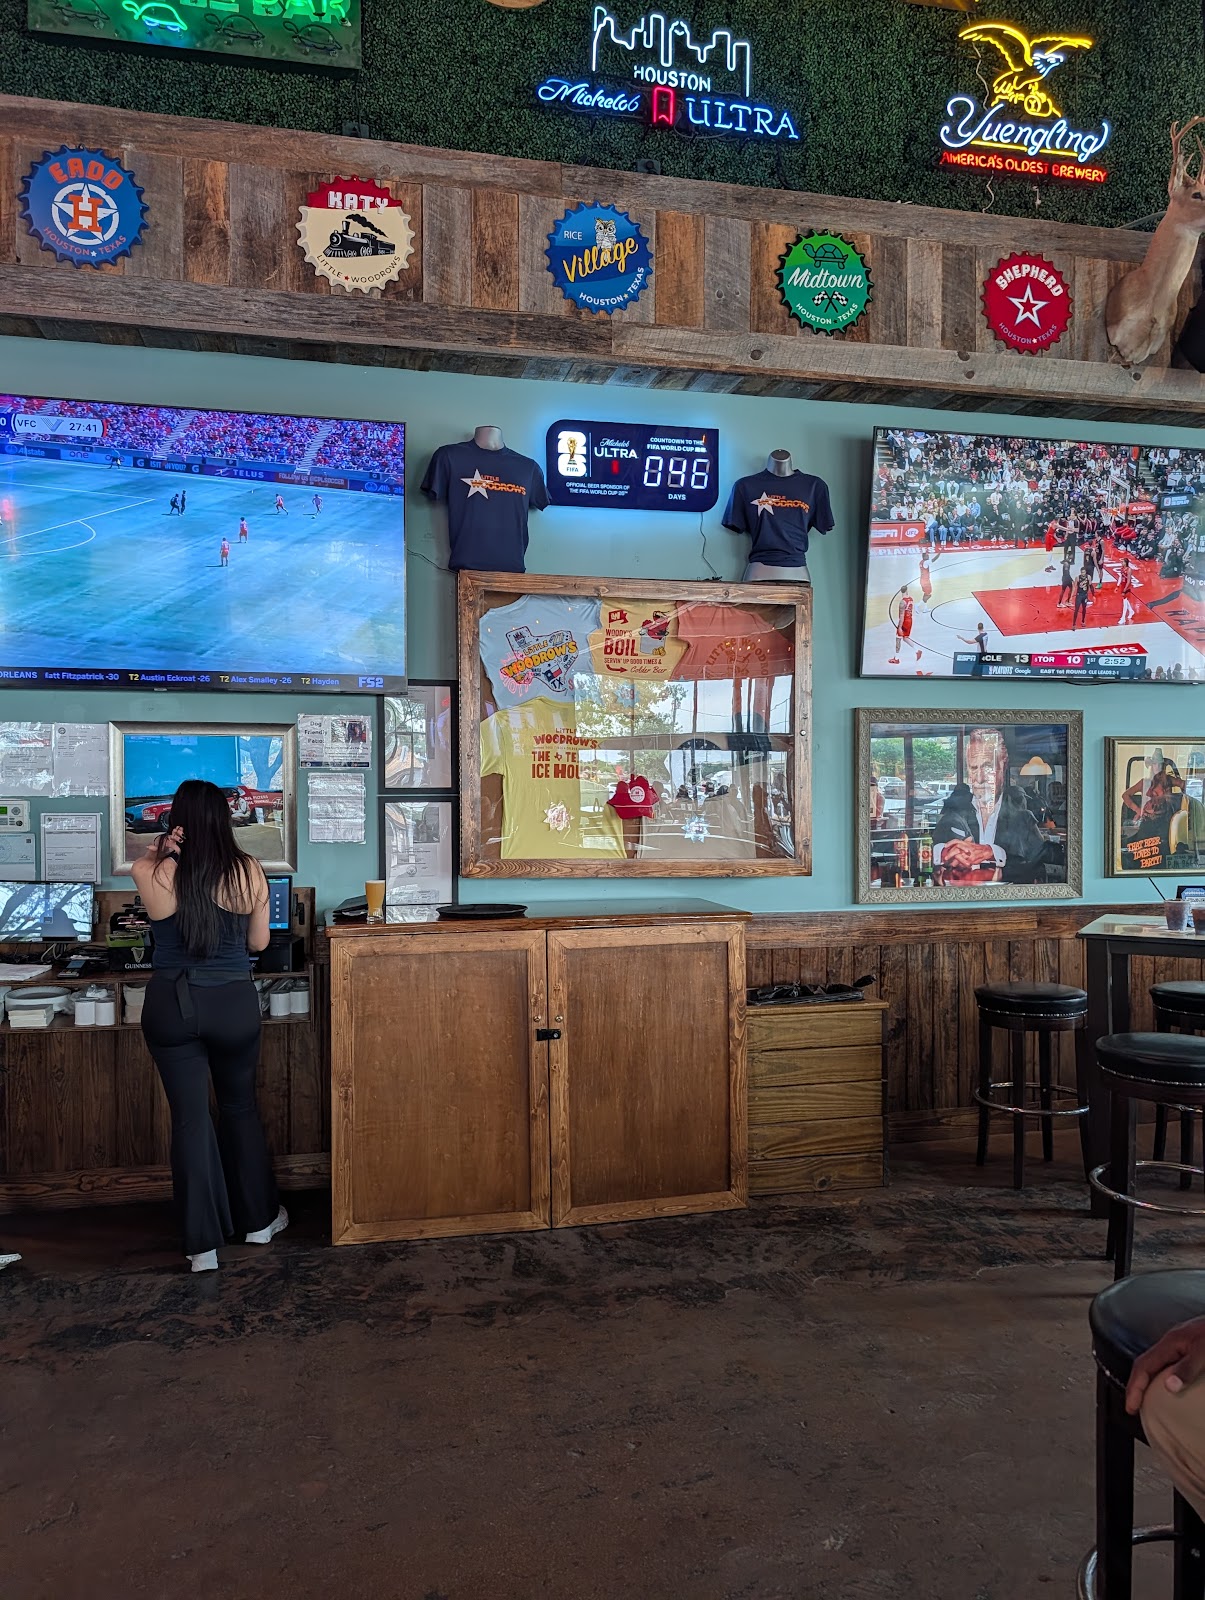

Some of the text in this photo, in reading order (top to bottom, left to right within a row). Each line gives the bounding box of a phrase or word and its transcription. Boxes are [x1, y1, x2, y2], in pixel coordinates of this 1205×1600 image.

[632, 64, 711, 93] HOUSTON
[537, 78, 799, 140] Michelob ULTRA
[939, 96, 1109, 163] Yuengling
[48, 157, 124, 190] EADO
[940, 151, 1107, 183] AMERICA'S OLDEST BREWERY
[327, 190, 389, 215] KATY
[67, 194, 103, 233] H
[43, 226, 127, 256] HOUSTON TEXAS
[563, 230, 583, 241] RICE
[562, 237, 639, 283] Village
[316, 254, 401, 284] LITTLE WOODROWS
[787, 266, 865, 289] Midtown
[995, 263, 1064, 297] SHEPHERD
[579, 266, 645, 306] HOUSTON TEXAS
[795, 302, 859, 325] HOUSTON TEXAS
[999, 322, 1058, 344] HOUSTON TEXAS
[17, 419, 37, 428] VFC
[69, 422, 98, 433] 27:41
[367, 429, 391, 440] LIVE
[69, 450, 89, 459] one
[594, 447, 638, 459] ULTRA
[233, 468, 264, 478] TELUS
[643, 455, 710, 490] 046
[605, 628, 632, 637] WOODY'S
[603, 637, 638, 656] BOIL
[1014, 655, 1029, 663] 13
[1066, 656, 1081, 664] 10
[61, 672, 105, 681] Fitzpatrick
[129, 673, 140, 681] T2
[140, 674, 166, 682] Austin
[219, 675, 230, 683] T2
[248, 676, 278, 685] Smalley
[358, 676, 384, 688] FS2
[550, 677, 564, 689] TX
[533, 734, 598, 749] WOODROW'S
[532, 751, 551, 762] THE
[532, 764, 550, 779] ICE
[1151, 846, 1159, 855] TO
[1140, 855, 1163, 868] PARTY!
